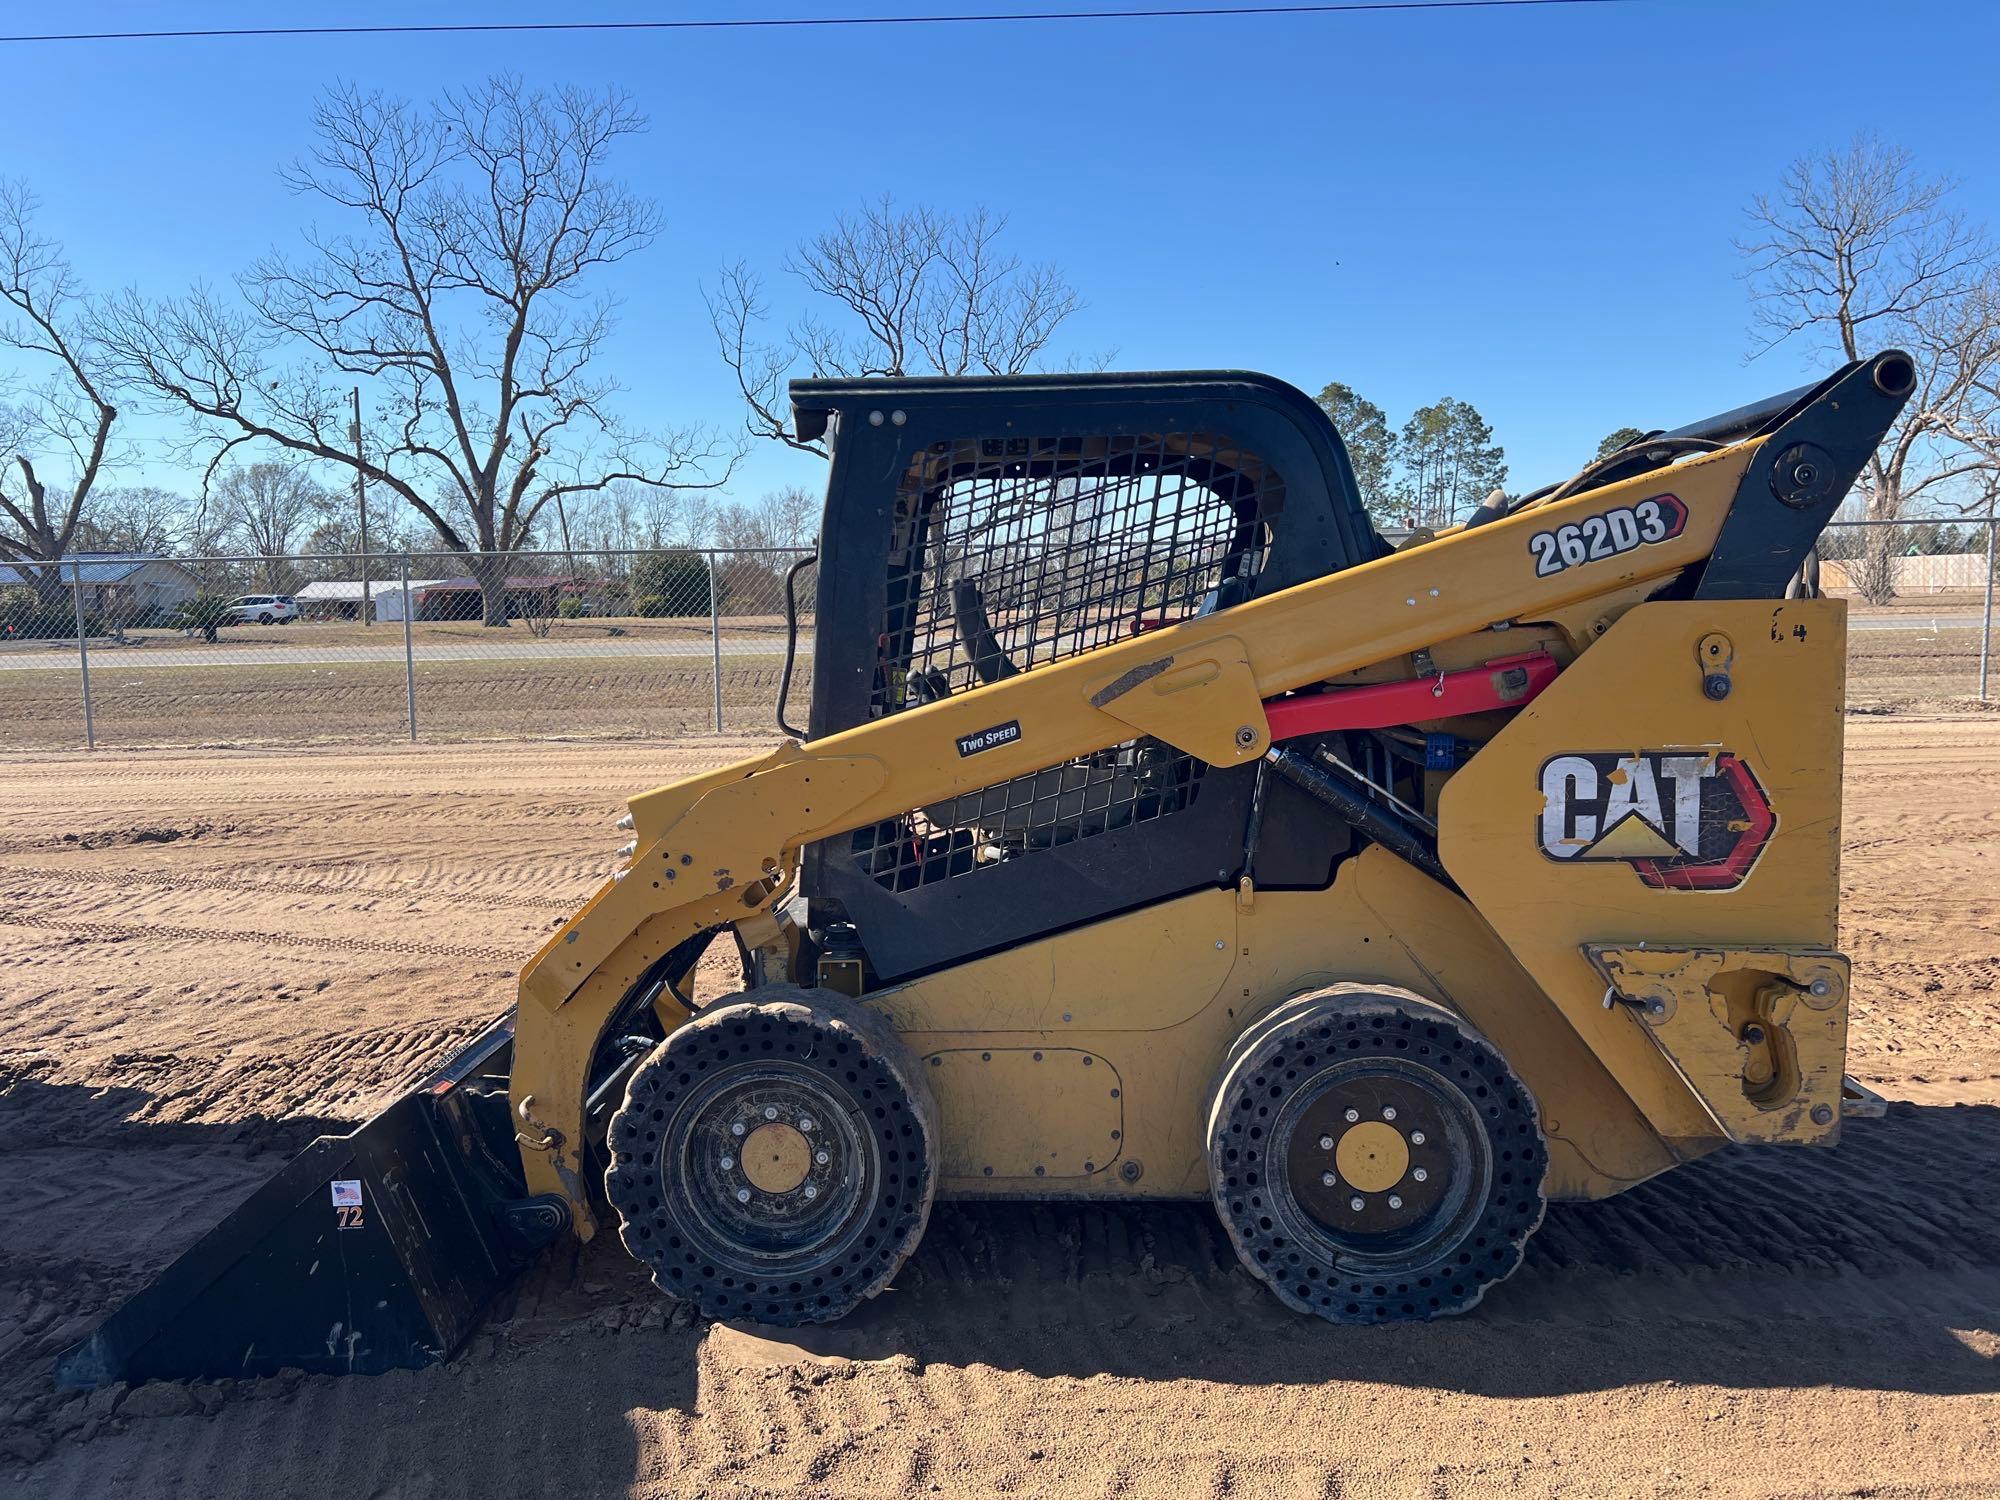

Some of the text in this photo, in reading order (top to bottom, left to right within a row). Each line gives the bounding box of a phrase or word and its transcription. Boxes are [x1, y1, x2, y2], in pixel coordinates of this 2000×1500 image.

[1531, 501, 1666, 575] 262D3
[1542, 757, 1716, 858] CAT
[336, 1205, 364, 1227] 72
